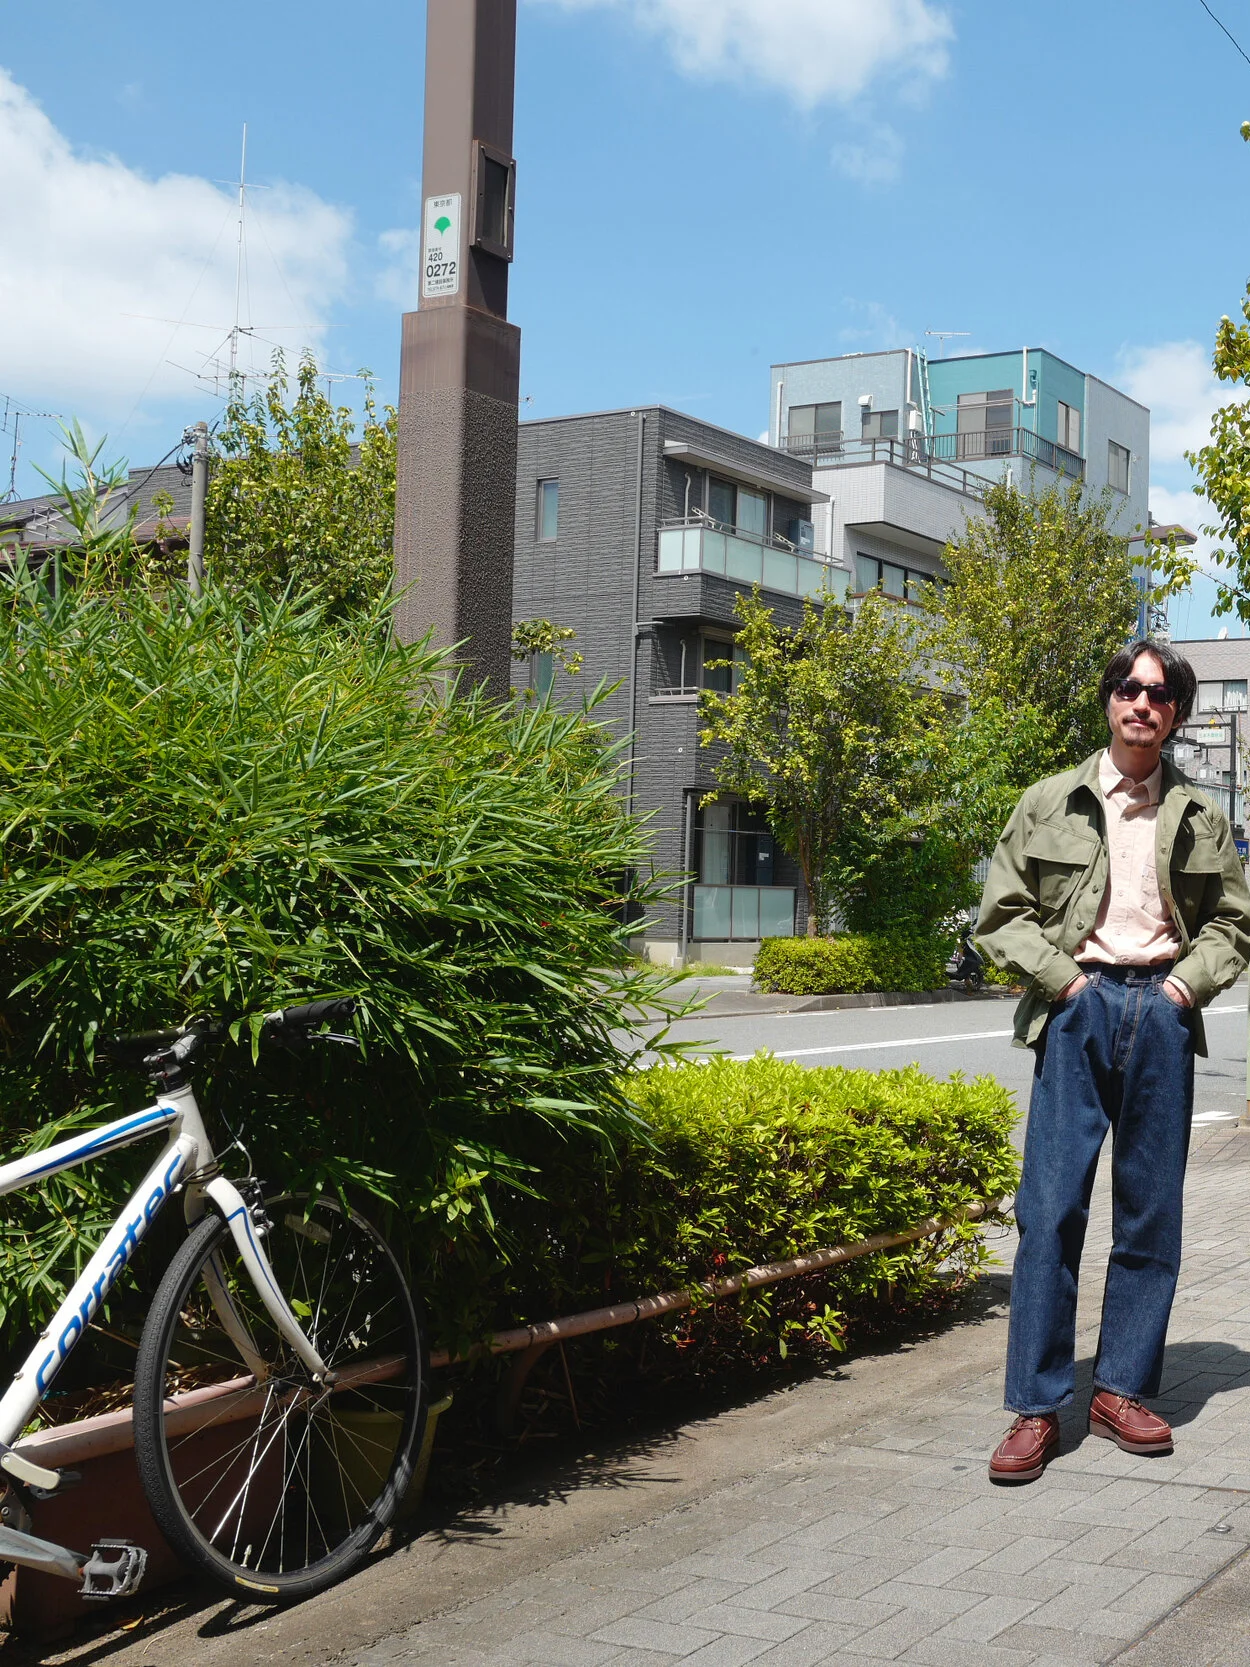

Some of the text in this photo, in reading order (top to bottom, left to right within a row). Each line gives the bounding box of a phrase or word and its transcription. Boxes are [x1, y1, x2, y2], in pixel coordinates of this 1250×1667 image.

[428, 252, 443, 262] 420
[426, 261, 456, 278] 0272
[36, 1154, 187, 1396] corratec
